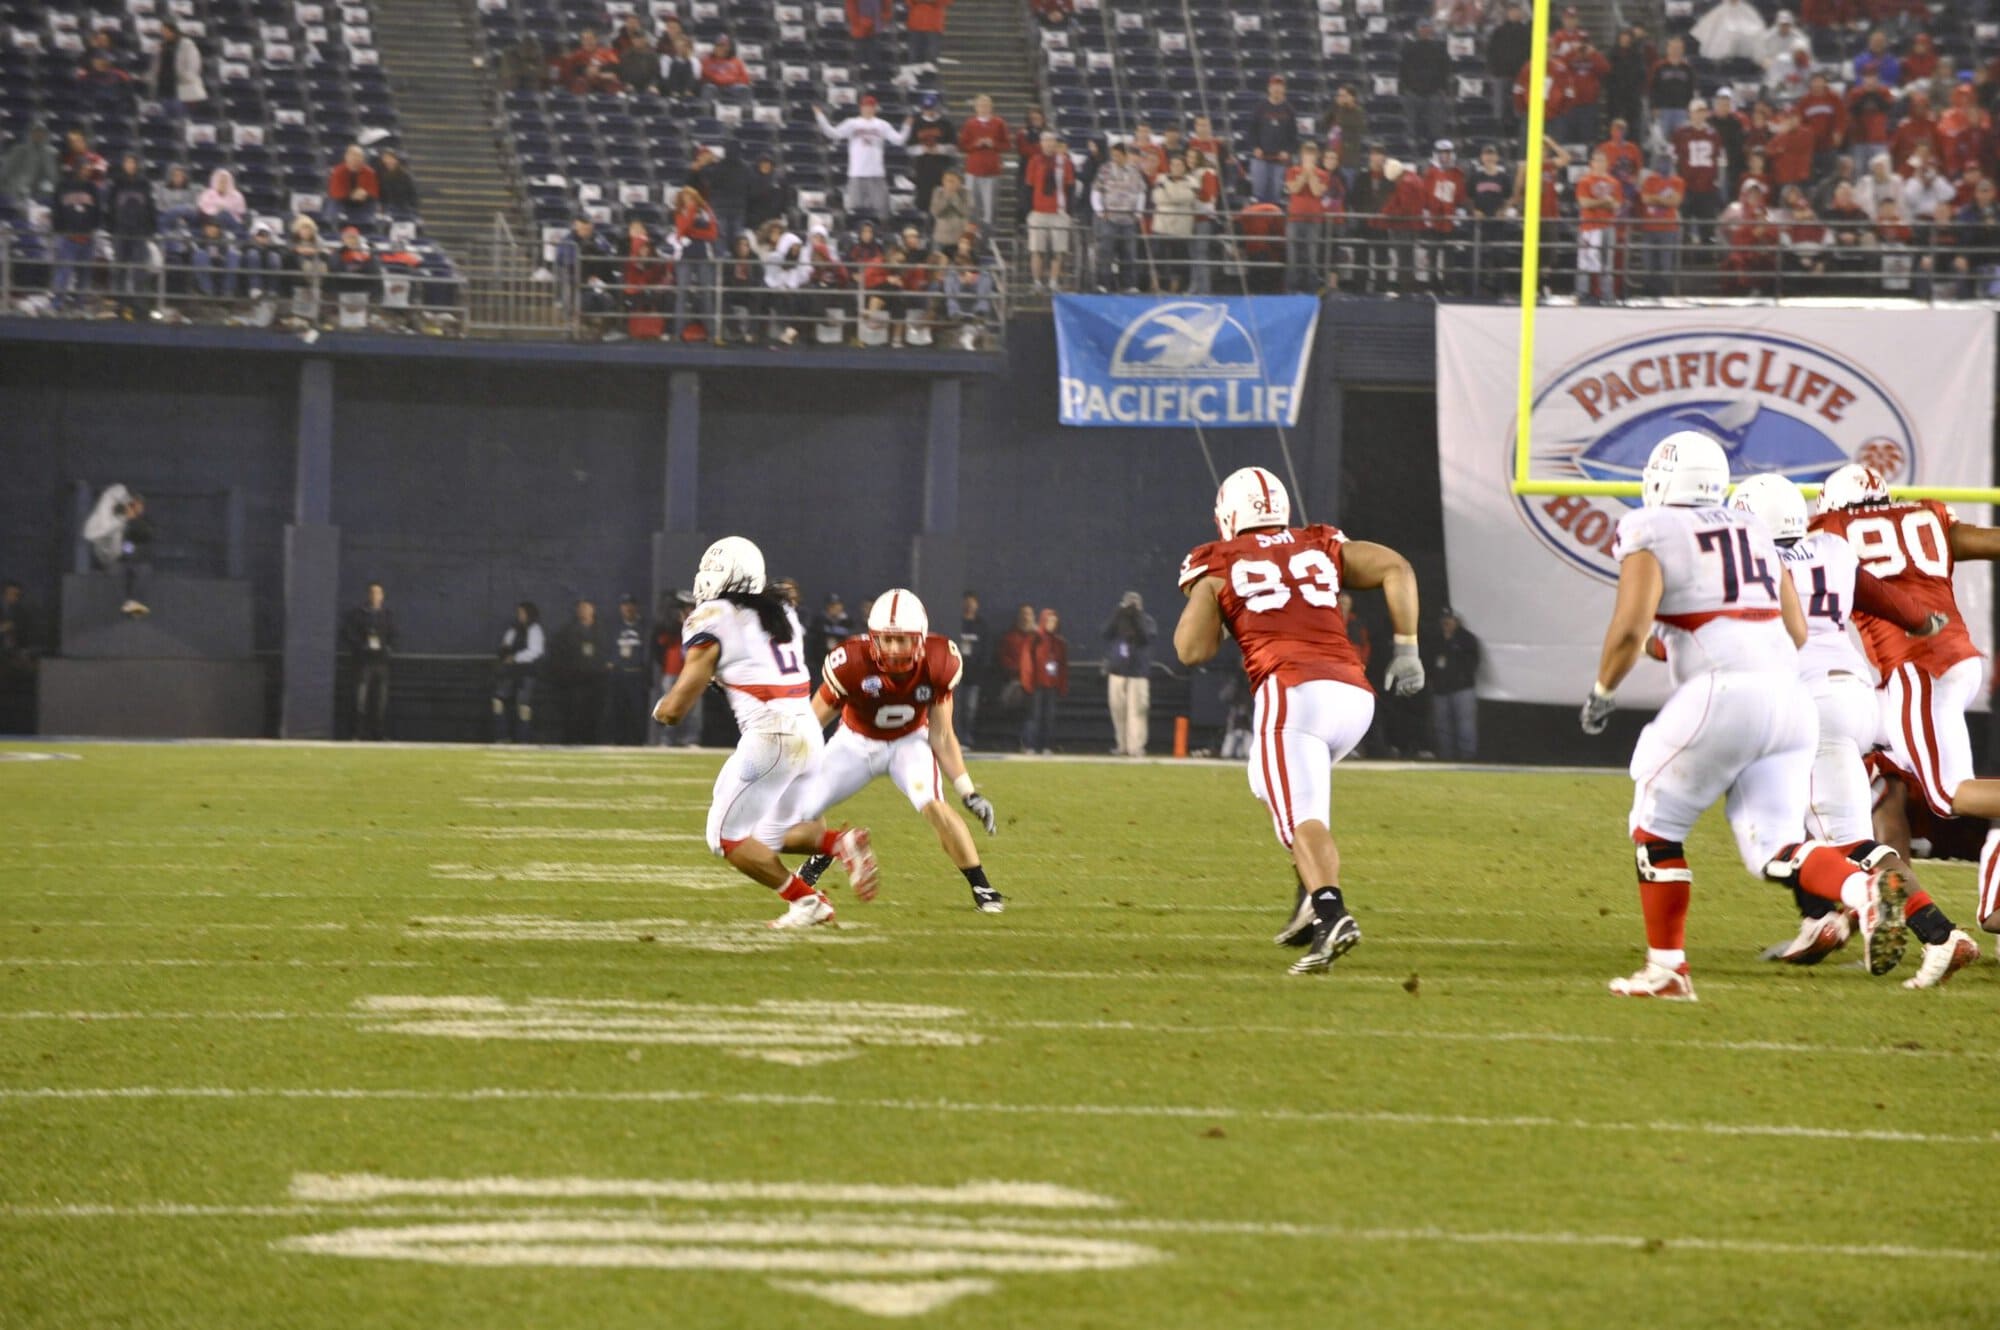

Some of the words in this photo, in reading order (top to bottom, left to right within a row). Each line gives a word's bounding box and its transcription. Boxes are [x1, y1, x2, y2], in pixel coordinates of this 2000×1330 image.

[1060, 375, 1218, 422] PACIFIC
[1225, 379, 1296, 422] LIF
[1568, 350, 1749, 422] PACIFIC
[1752, 348, 1858, 424] LIFE
[1695, 528, 1778, 604] 74
[1846, 510, 1949, 579] 90
[1230, 549, 1340, 613] 93
